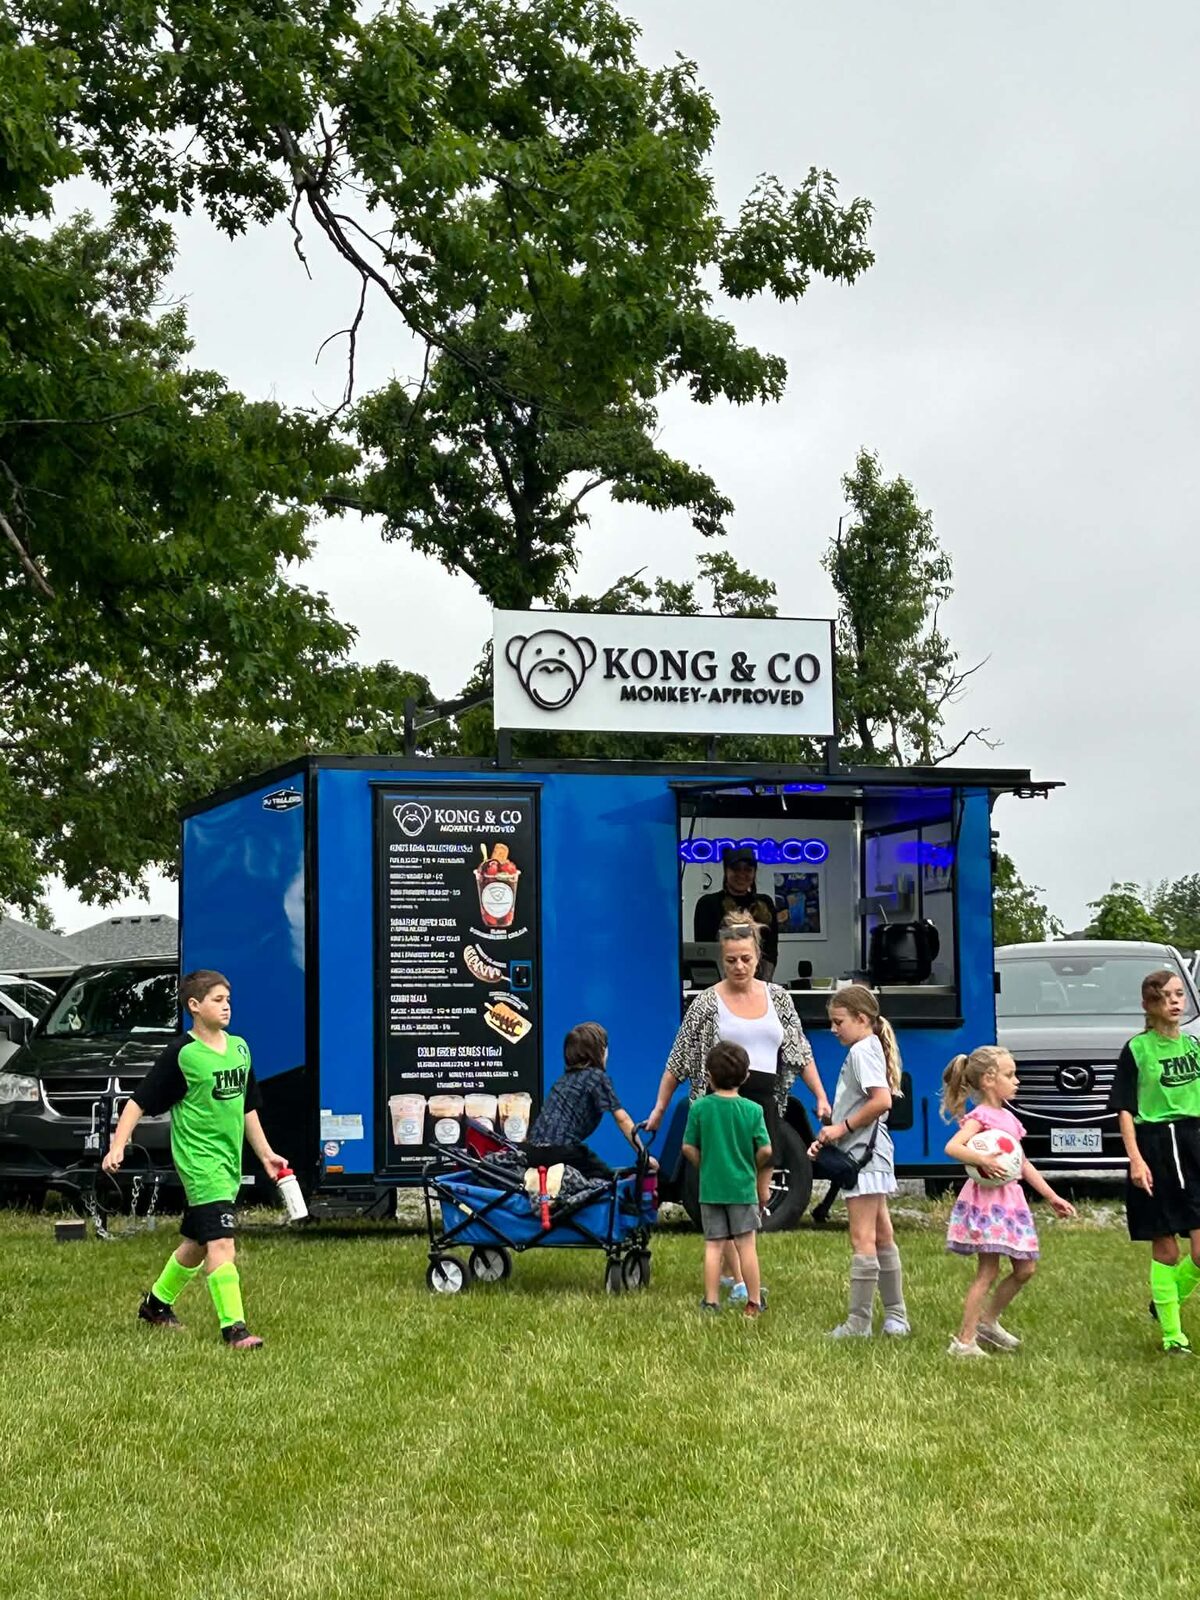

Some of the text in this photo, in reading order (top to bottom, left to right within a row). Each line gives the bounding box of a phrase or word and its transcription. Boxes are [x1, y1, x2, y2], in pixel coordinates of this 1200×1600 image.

[603, 647, 821, 684] KONG & CO
[620, 685, 804, 706] MONKEY-APPROVED
[434, 809, 522, 824] KONG & CO
[417, 1046, 436, 1057] COLD
[457, 1046, 481, 1057] SERIES
